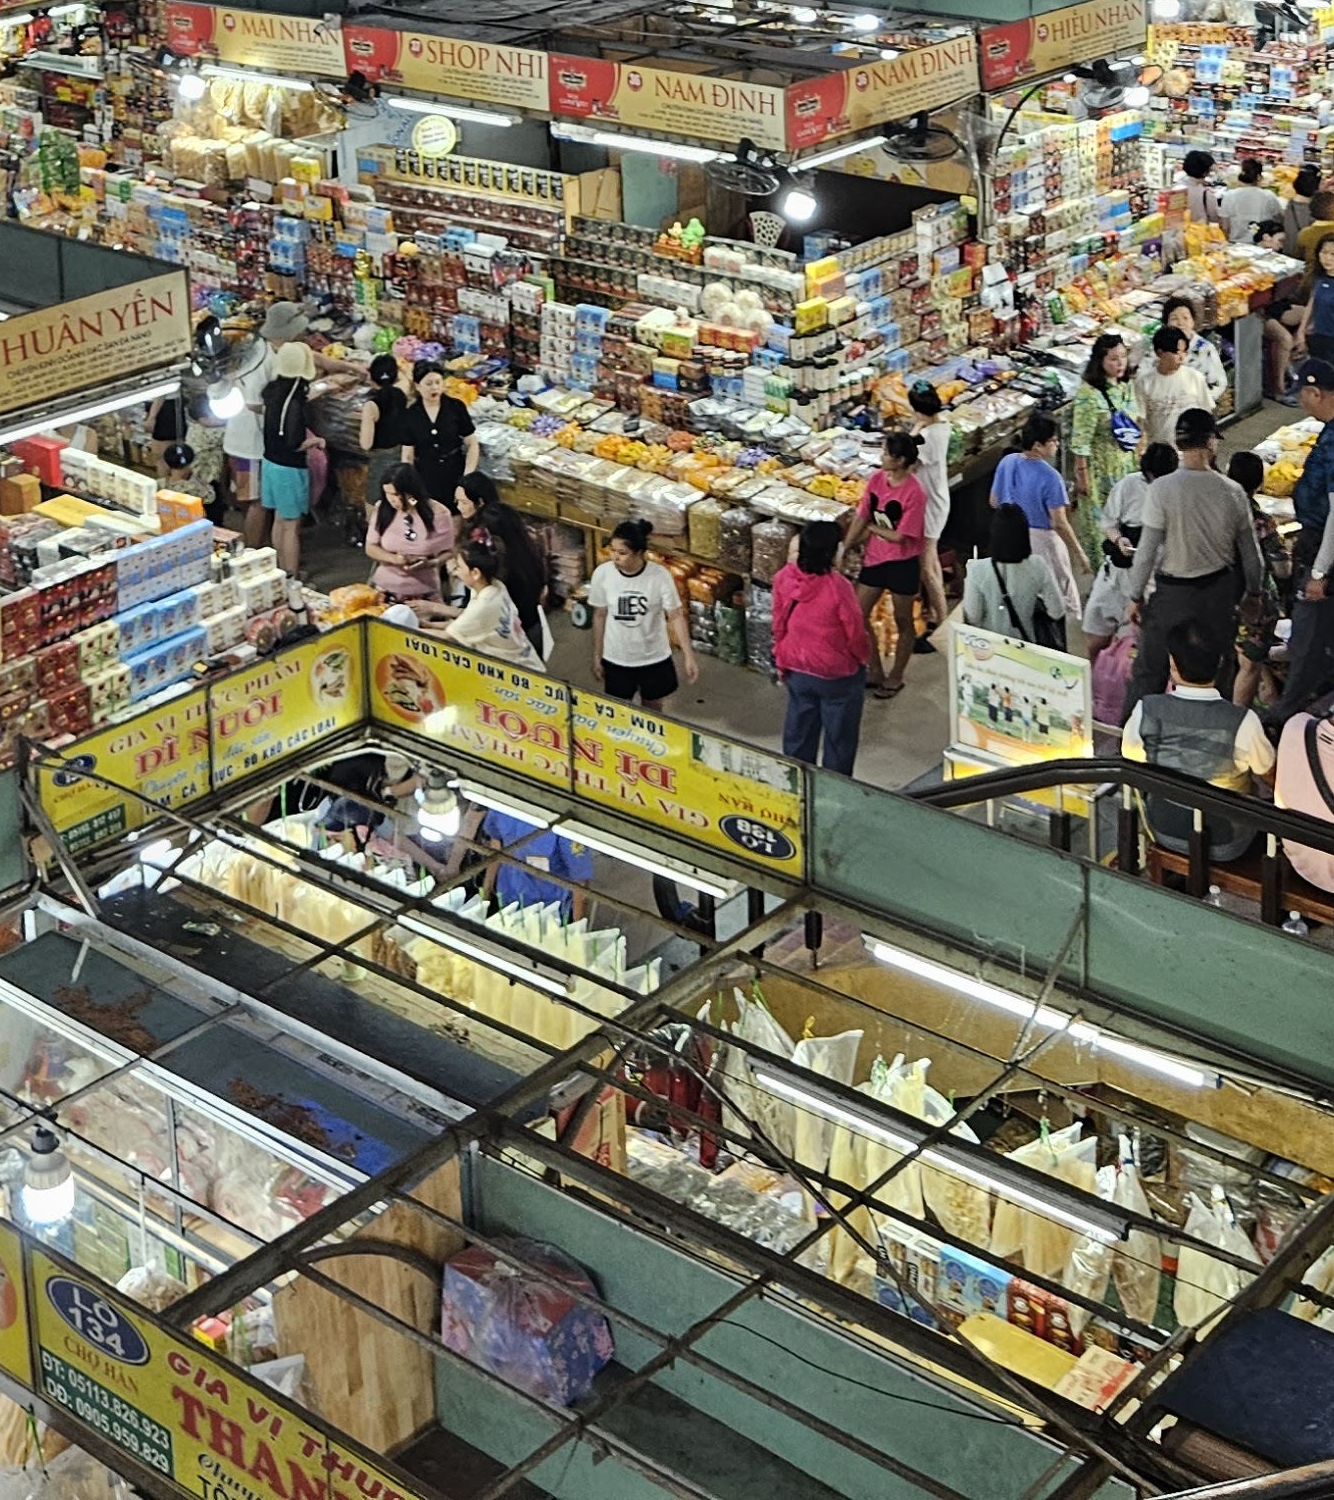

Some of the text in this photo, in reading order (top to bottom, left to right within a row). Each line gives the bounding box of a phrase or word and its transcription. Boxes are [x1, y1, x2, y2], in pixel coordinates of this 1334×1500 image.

[240, 15, 274, 38] MAI
[427, 43, 544, 80] SHOP NHI
[871, 56, 917, 91] NAM
[655, 77, 705, 105] NAM
[711, 87, 777, 122] ĐỊNH
[109, 289, 174, 332] YẾN
[134, 735, 180, 779] DÌ
[616, 749, 677, 794] DÌ
[73, 1287, 119, 1329] LÔ
[68, 1306, 126, 1357] 134
[63, 1334, 140, 1395] CHỢ HÀN
[42, 1350, 170, 1451] ĐT: 05113.826.923
[167, 1351, 283, 1441] GIA VỊ
[75, 1396, 169, 1474] 0905.959.829
